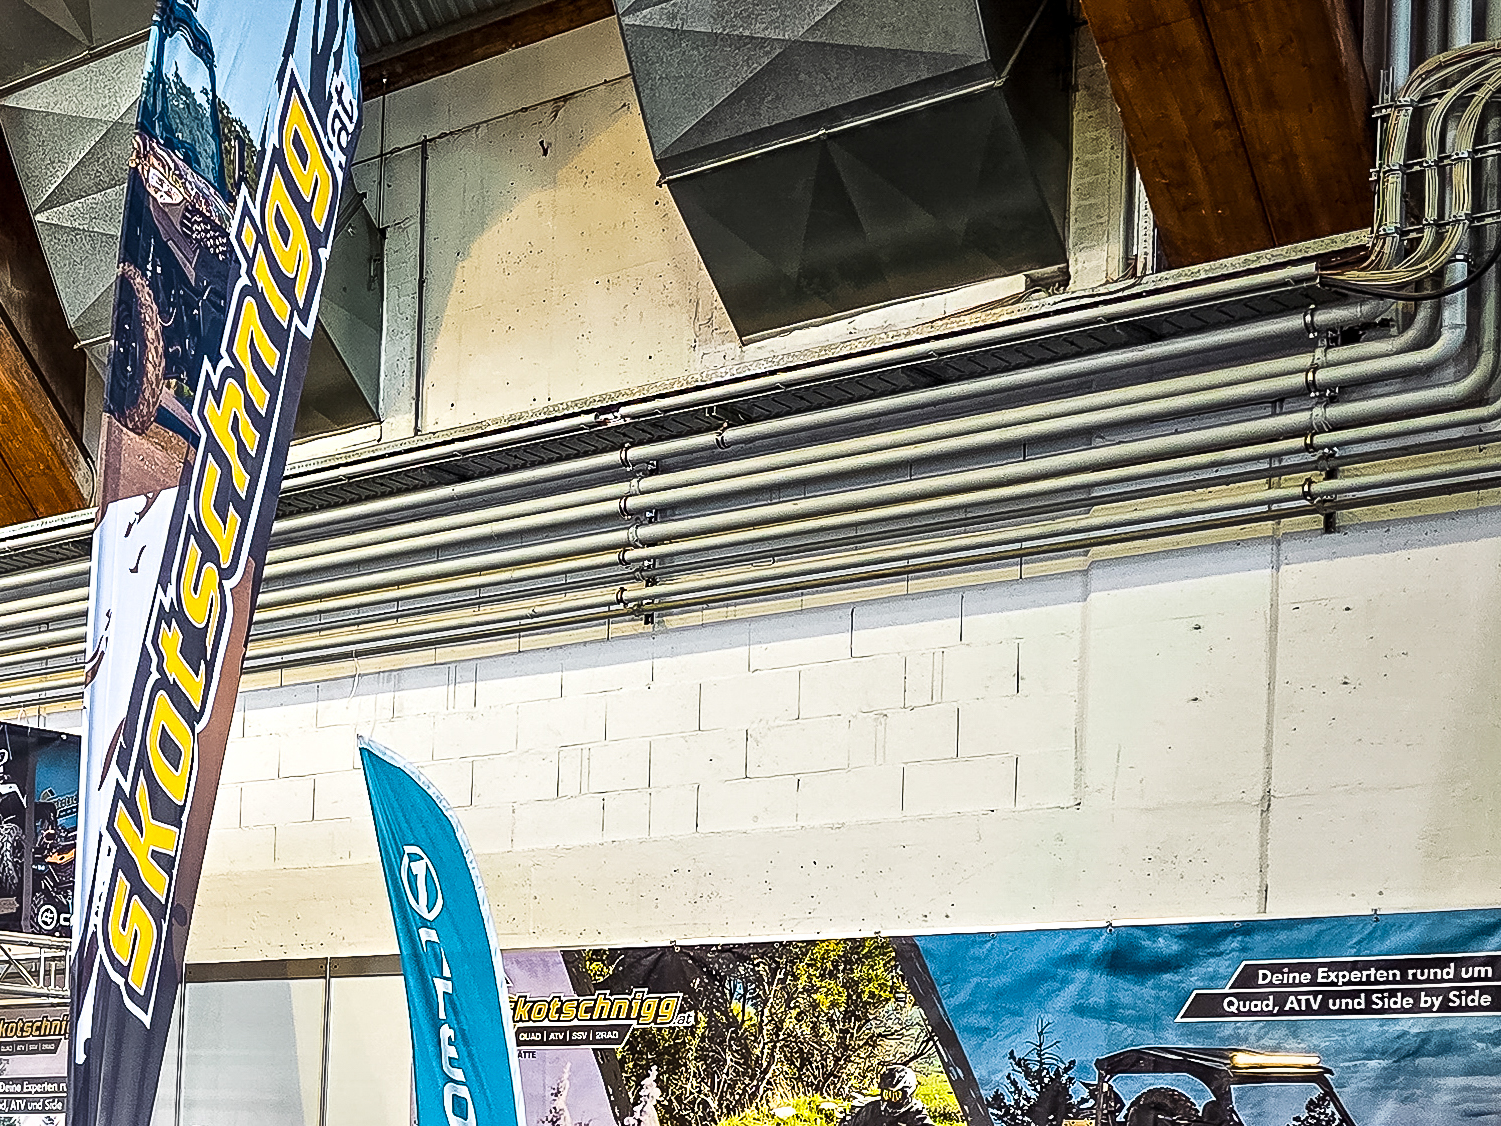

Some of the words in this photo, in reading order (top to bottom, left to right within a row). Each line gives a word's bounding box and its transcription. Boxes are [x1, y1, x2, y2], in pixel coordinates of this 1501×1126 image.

[1257, 967, 1311, 985] Deine
[1316, 966, 1400, 986] Experten
[1407, 963, 1455, 981] rund
[1460, 965, 1493, 979] um
[1222, 995, 1279, 1013] Quad,
[1283, 994, 1323, 1011] ATV
[1328, 992, 1365, 1010] und
[1371, 992, 1414, 1009] Side
[1419, 991, 1443, 1011] by
[1448, 989, 1492, 1007] Side
[519, 1032, 541, 1041] QUAD
[549, 1032, 565, 1041] ATV
[571, 1031, 588, 1040] SSV
[595, 1031, 619, 1040] 2RAD
[23, 1081, 58, 1095] Experten
[11, 1100, 26, 1111] ATV
[27, 1099, 43, 1111] und
[44, 1099, 63, 1111] Side
